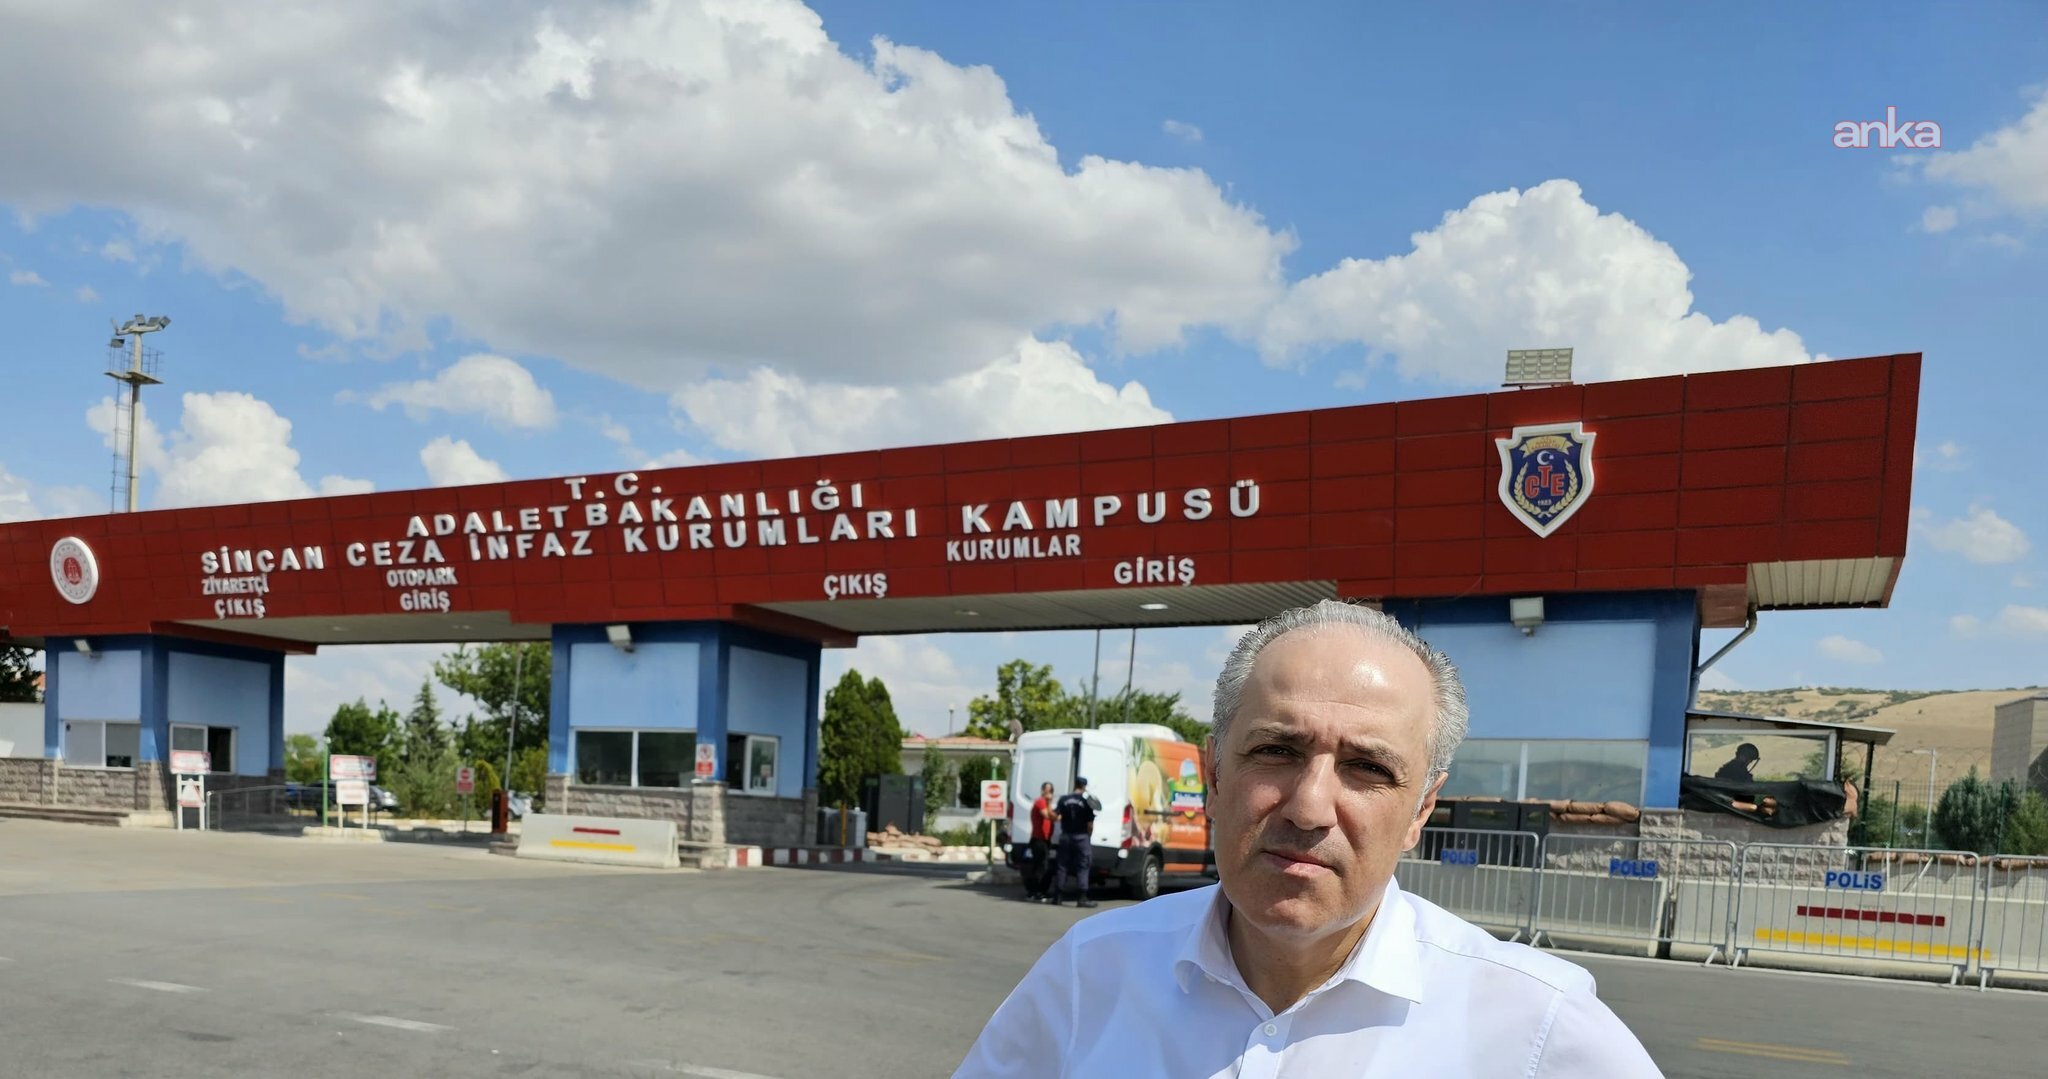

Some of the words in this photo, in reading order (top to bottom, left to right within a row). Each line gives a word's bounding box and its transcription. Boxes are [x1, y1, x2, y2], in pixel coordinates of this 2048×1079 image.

[406, 504, 569, 538] ADALET
[585, 478, 863, 527] BAKANLIĞI
[201, 545, 324, 575] SİNCAN
[346, 539, 446, 567] CEZA
[469, 529, 593, 561] İNFAZ
[623, 508, 918, 552] KURUMLARI
[961, 479, 1261, 534] KAMPUSÜ
[946, 534, 1082, 562] KURUMLAR
[386, 566, 458, 588] OTOPARK
[1113, 555, 1196, 587] GİRİŞ
[823, 572, 889, 600] ÇIKIŞ
[214, 598, 266, 620] ÇIKIŞ
[400, 587, 451, 614] GİRİŞ
